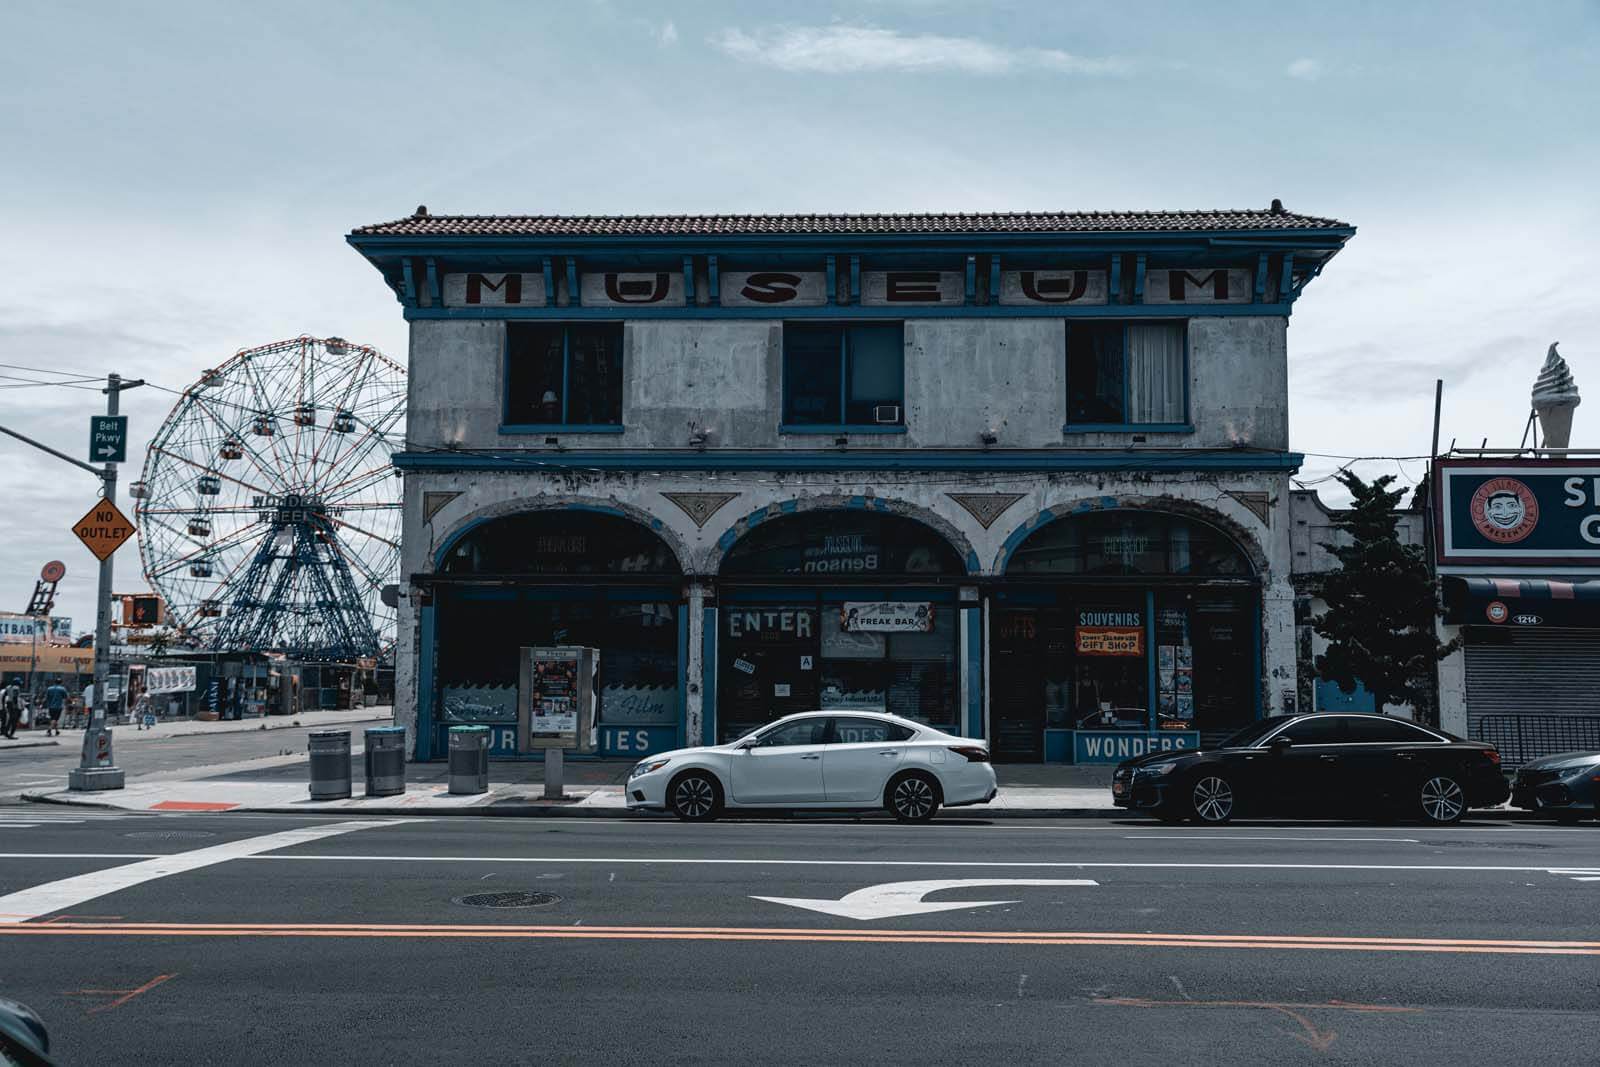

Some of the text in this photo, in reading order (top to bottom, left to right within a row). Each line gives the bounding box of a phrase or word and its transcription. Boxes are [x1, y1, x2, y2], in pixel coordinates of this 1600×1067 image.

[466, 269, 1226, 304] MUSEUM
[99, 421, 119, 431] Belt
[96, 432, 121, 444] Pkwy
[253, 496, 322, 508] WONDER
[96, 511, 113, 522] NO
[80, 527, 127, 539] OUTLET
[1484, 523, 1529, 539] PRESENTS
[729, 610, 813, 639] ENTER
[1080, 612, 1140, 626] SOUVENIRS
[1517, 615, 1537, 624] 1214
[11, 623, 33, 635] BAR
[1082, 641, 1136, 650] GIFT SHOP
[803, 657, 810, 666] A
[621, 694, 665, 715] Film
[822, 694, 842, 706] Coney
[843, 693, 866, 704] Island
[866, 694, 884, 703] USA
[1085, 737, 1187, 758] WONDERS
